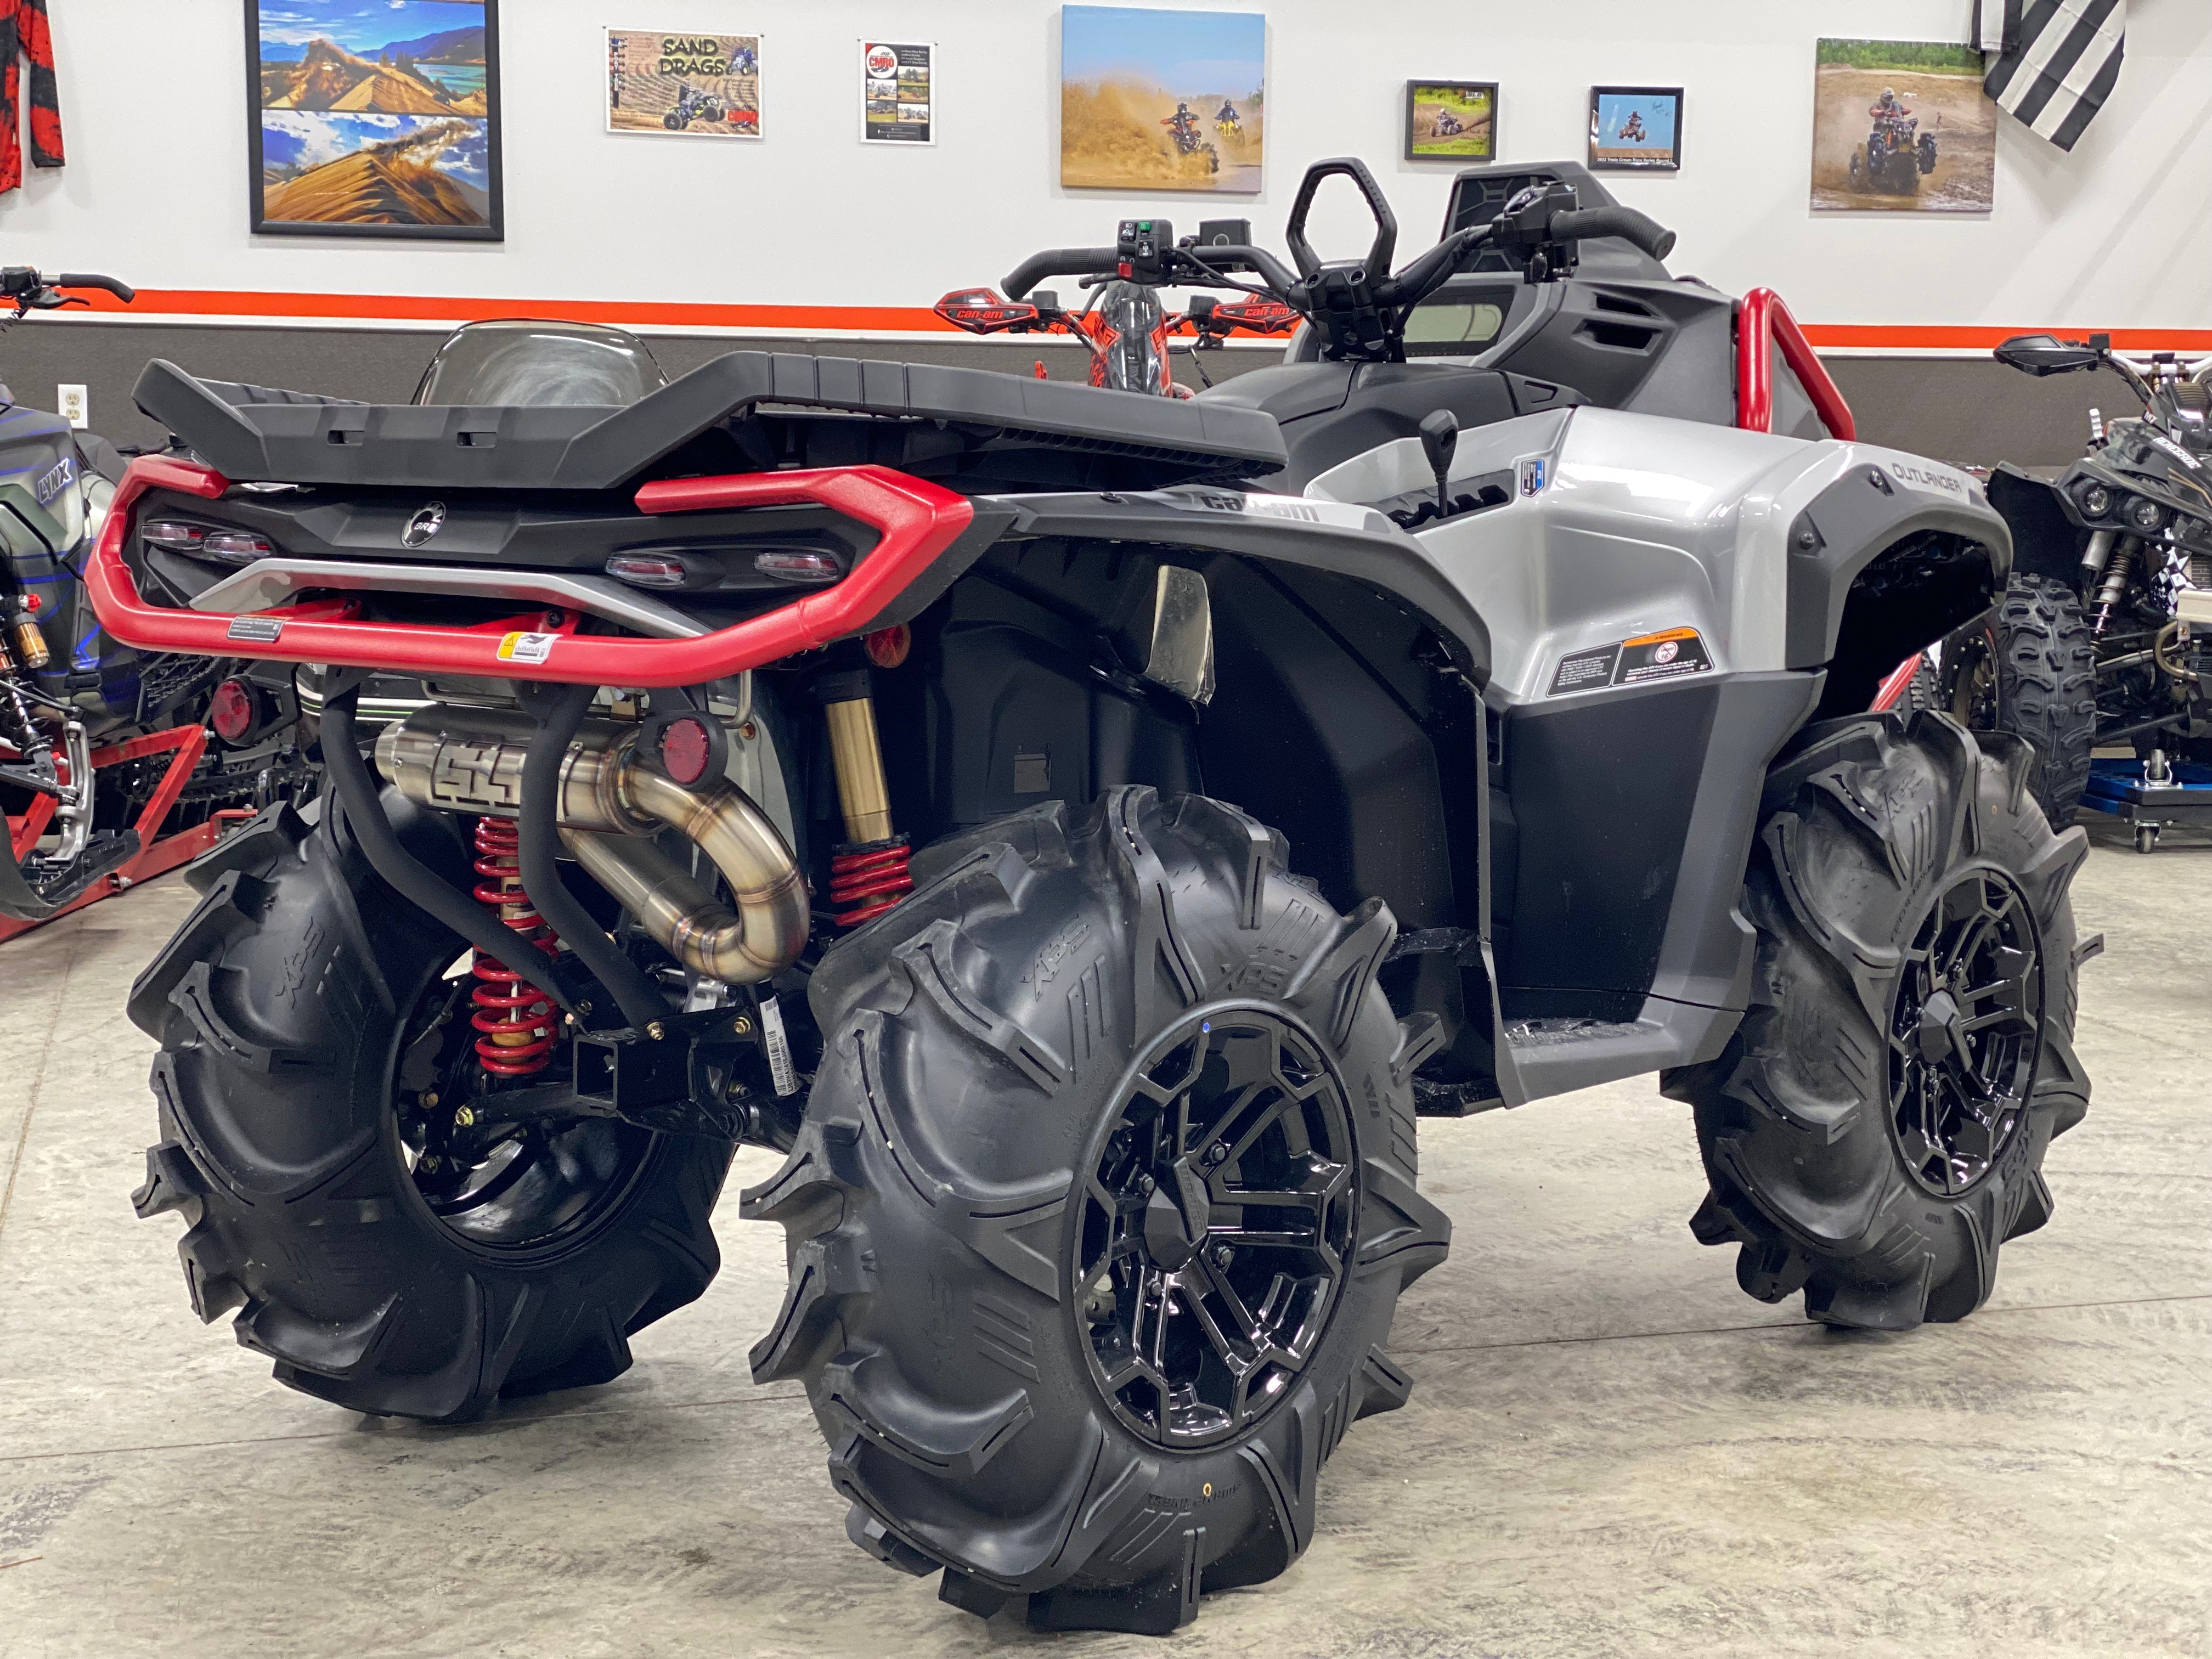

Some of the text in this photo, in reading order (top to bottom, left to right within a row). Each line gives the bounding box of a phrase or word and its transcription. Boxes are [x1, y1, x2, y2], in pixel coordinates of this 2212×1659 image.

[663, 37, 718, 56] SAND
[659, 57, 726, 76] DRAGS
[869, 57, 895, 67] CMRO
[956, 308, 1003, 319] can-am
[1243, 306, 1290, 317] can-am
[2153, 437, 2202, 469] RENEGADE
[38, 458, 73, 504] LYNX
[1891, 462, 1962, 494] OUTLANDER
[1200, 495, 1321, 522] caam
[414, 522, 438, 533] BR
[275, 916, 326, 1011] XPS
[1019, 913, 1092, 1002] XPS
[1210, 954, 1290, 994] XPS
